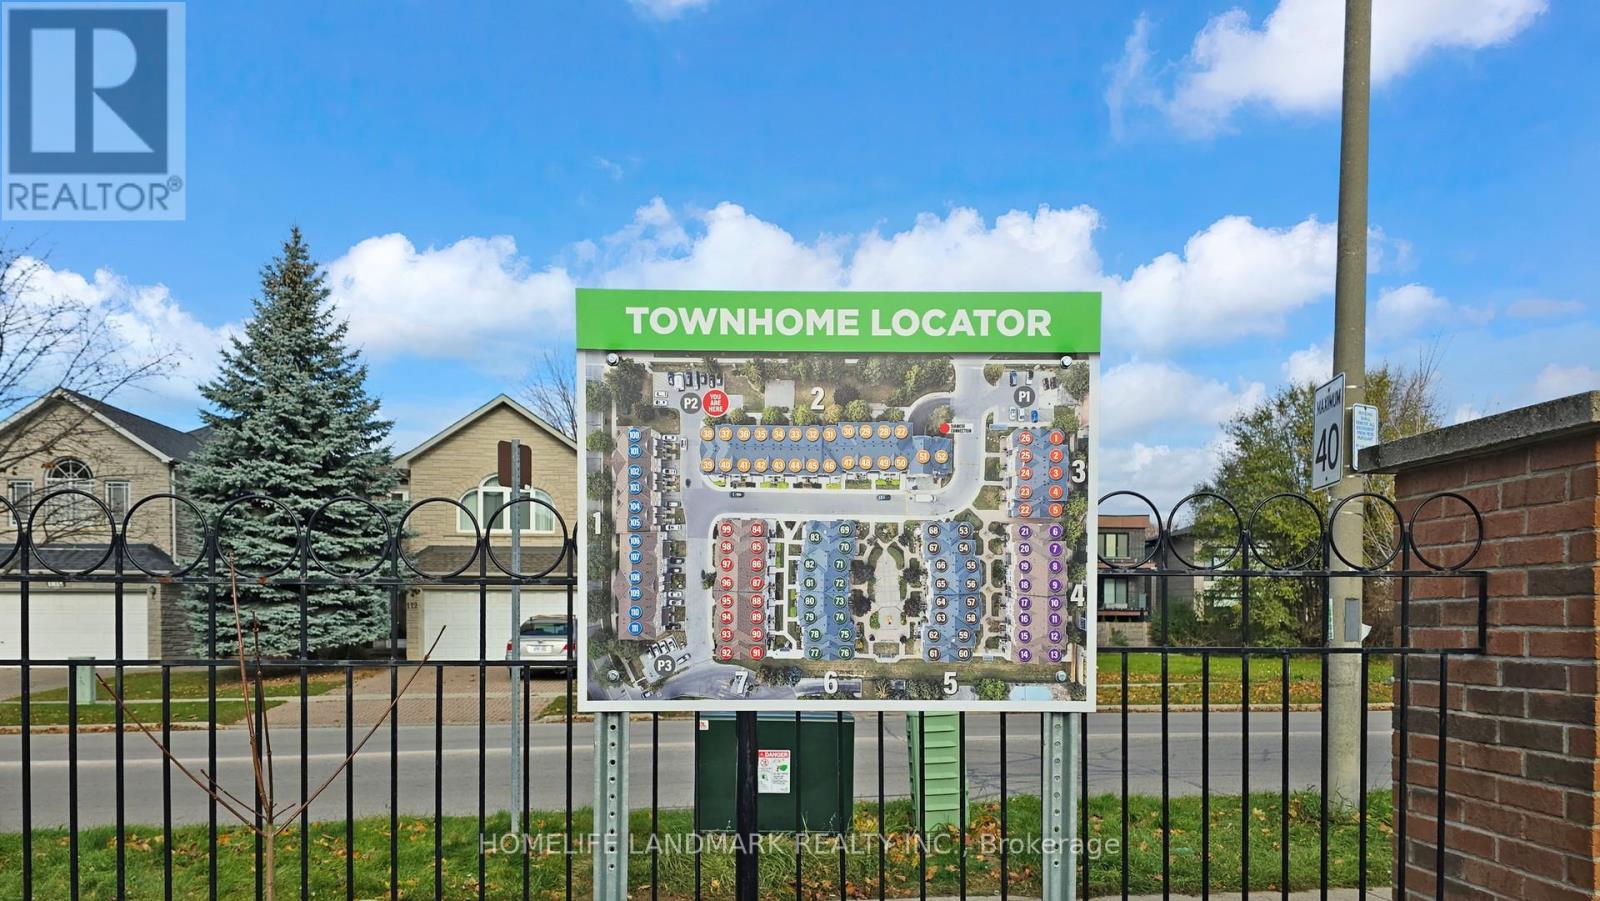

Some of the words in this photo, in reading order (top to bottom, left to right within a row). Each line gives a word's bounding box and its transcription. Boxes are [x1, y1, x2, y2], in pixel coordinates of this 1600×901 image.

[625, 306, 859, 336] TOWNHOME
[871, 308, 1052, 337] LOCATOR
[684, 398, 698, 409] P2
[811, 387, 825, 409] 2
[1019, 391, 1030, 402] P1
[1316, 388, 1342, 416] MAXIMUM
[1315, 423, 1340, 472] 40
[1072, 460, 1086, 483] 3
[592, 512, 601, 534] 1
[1071, 584, 1084, 606] 4
[658, 661, 672, 671] P3
[736, 671, 748, 694] 7
[824, 671, 838, 693] 6
[944, 672, 957, 694] 5
